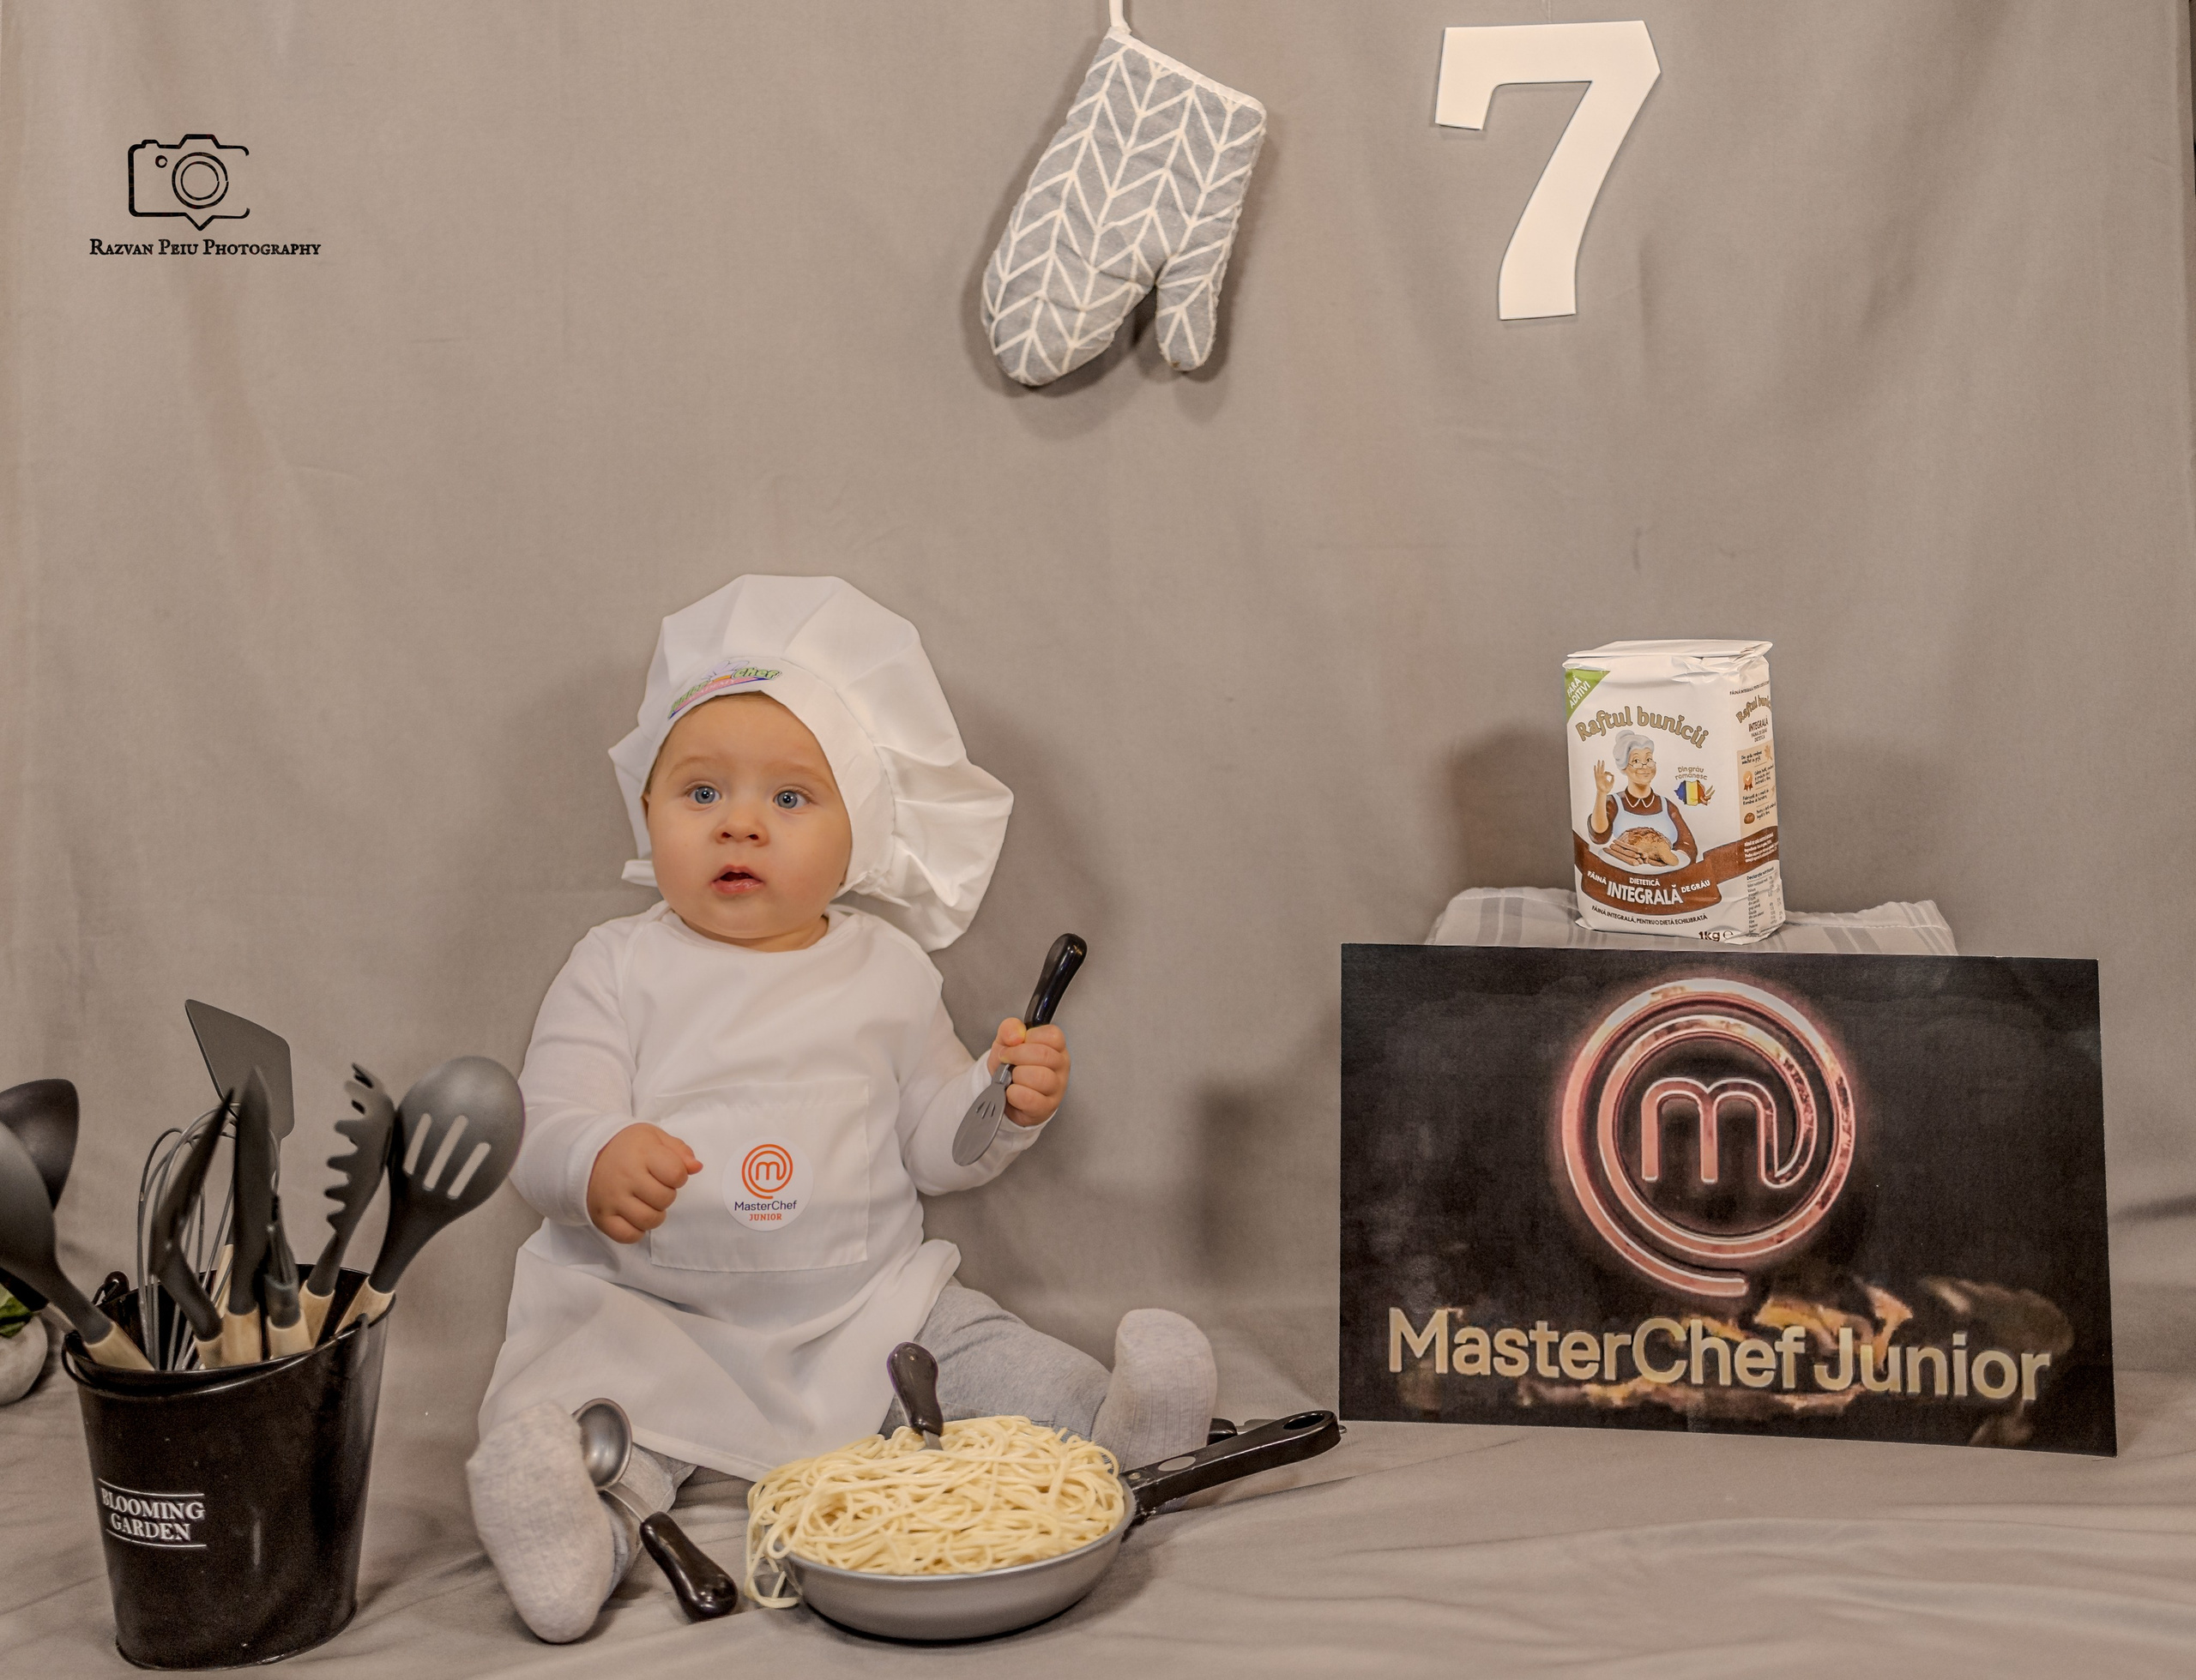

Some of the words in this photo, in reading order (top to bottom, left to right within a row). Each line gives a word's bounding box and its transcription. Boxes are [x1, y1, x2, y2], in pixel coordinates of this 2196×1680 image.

[1435, 21, 1661, 321] 7
[1569, 682, 1591, 709] ADITIVI
[1575, 705, 1633, 742] Raftul
[1637, 705, 1710, 749] bunicii
[1607, 881, 1684, 906] INTEGRALĂ
[1698, 930, 1721, 942] 1kg
[734, 1200, 798, 1211] MasterChef
[1386, 1306, 1806, 1390] MasterChef
[1813, 1327, 2053, 1402] Junior
[100, 1488, 206, 1520] BLOOMING
[110, 1514, 191, 1542] GARDEN
